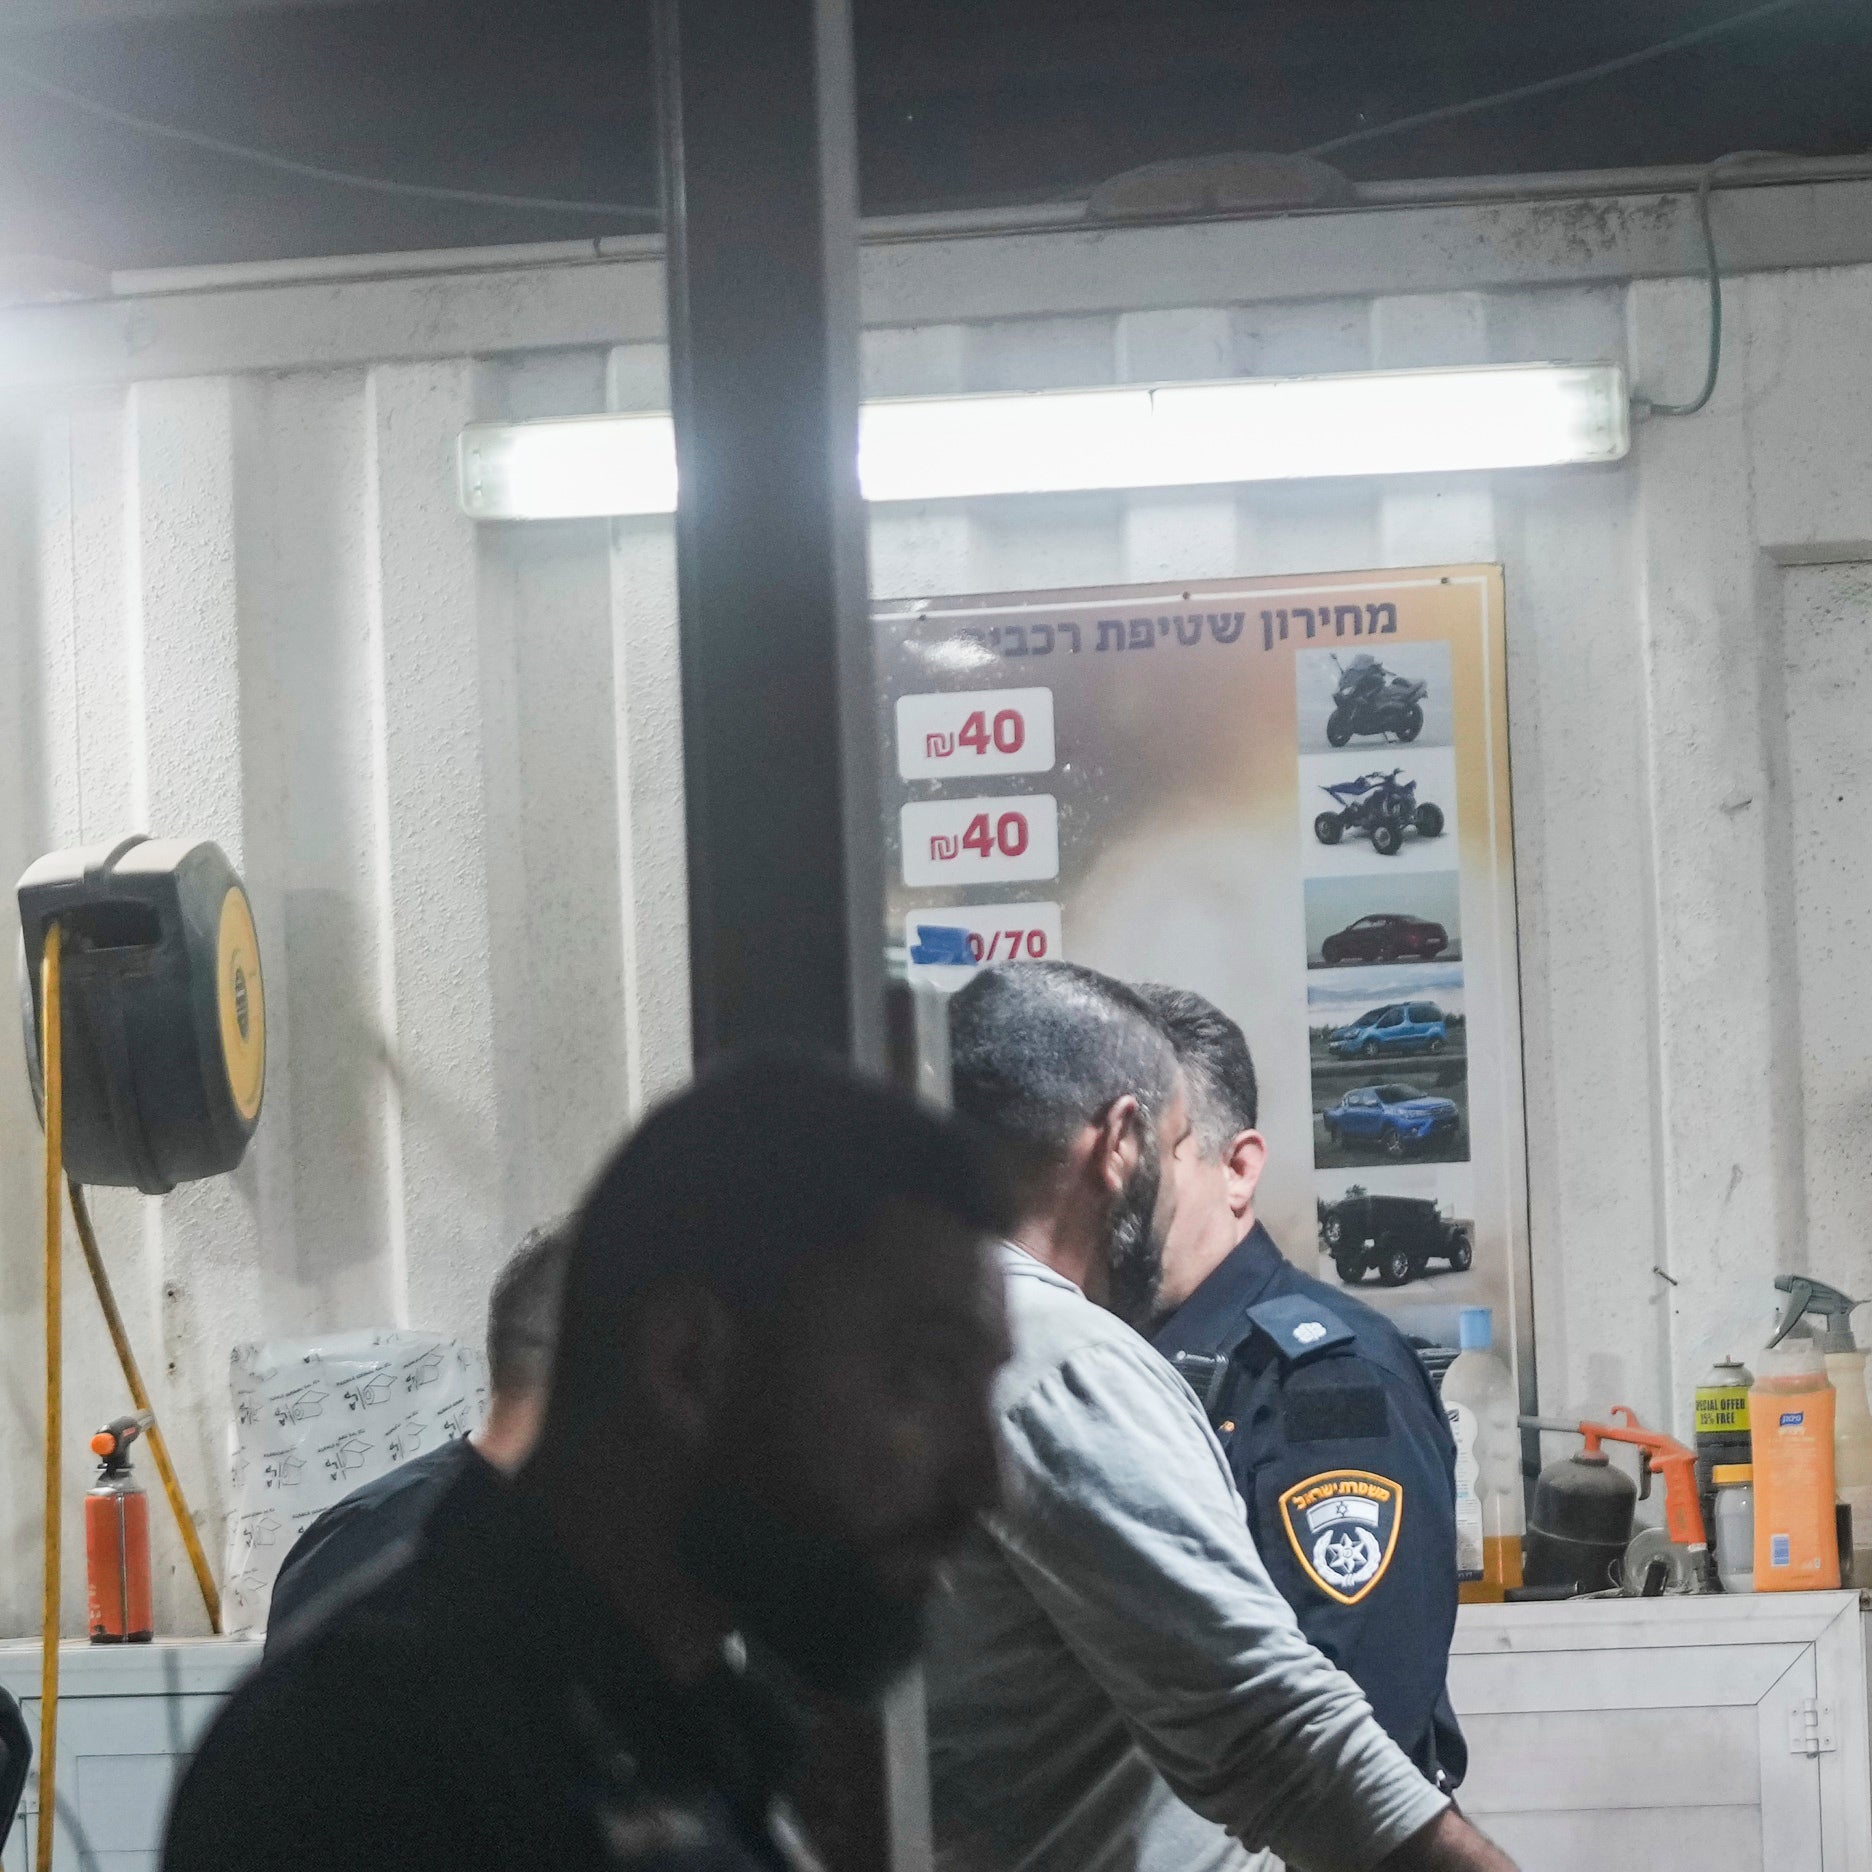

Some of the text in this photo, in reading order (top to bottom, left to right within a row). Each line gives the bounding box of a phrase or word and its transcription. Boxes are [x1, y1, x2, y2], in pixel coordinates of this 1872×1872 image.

[1095, 611, 1245, 652] שטיפת
[1260, 601, 1398, 650] מחירון
[1337, 1481, 1392, 1503] משטרת
